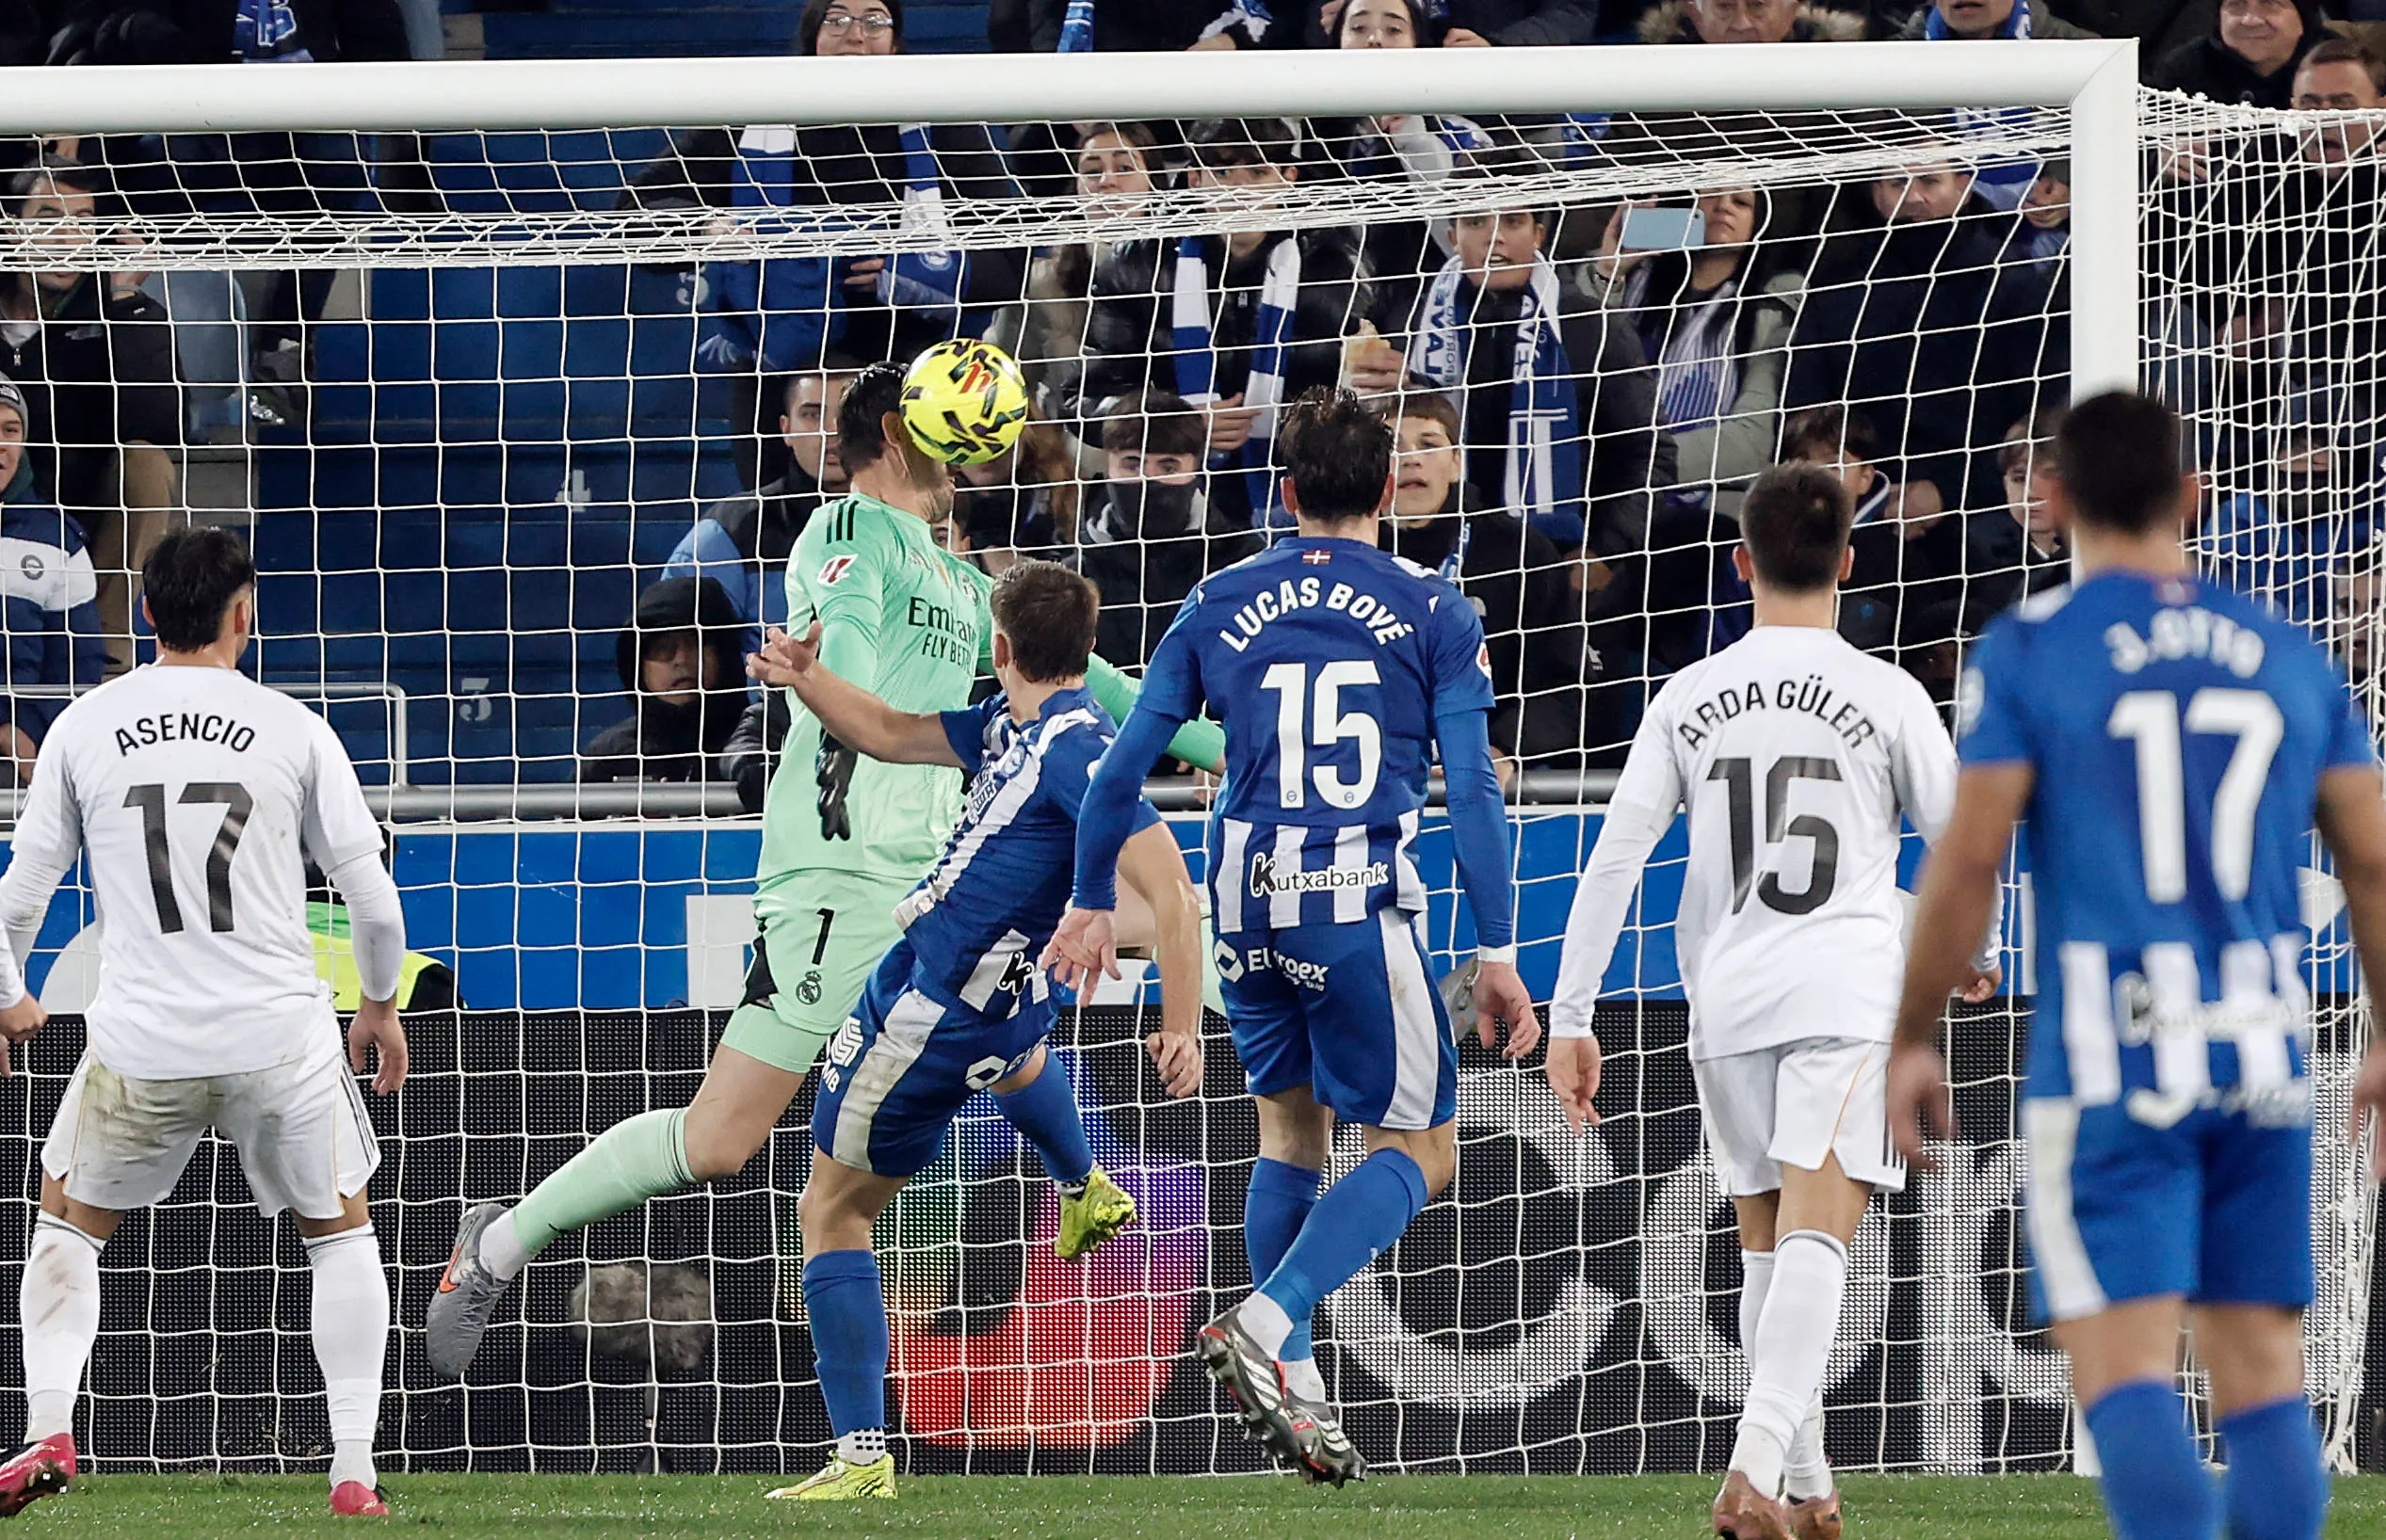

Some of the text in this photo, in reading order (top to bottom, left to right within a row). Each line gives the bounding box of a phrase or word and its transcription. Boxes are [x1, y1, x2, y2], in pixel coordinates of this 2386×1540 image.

[922, 633, 948, 659] FLY
[1219, 576, 1415, 653] LUCAS BOYÉ
[115, 713, 256, 758] ASENCIO
[1260, 660, 1382, 810] 15
[1678, 673, 1875, 751] ARDA GÜLER
[2106, 686, 2286, 905] 17
[122, 782, 254, 934] 17
[1250, 852, 1390, 897] Kutxabank
[1706, 757, 1844, 916] 15
[813, 907, 835, 966] 1
